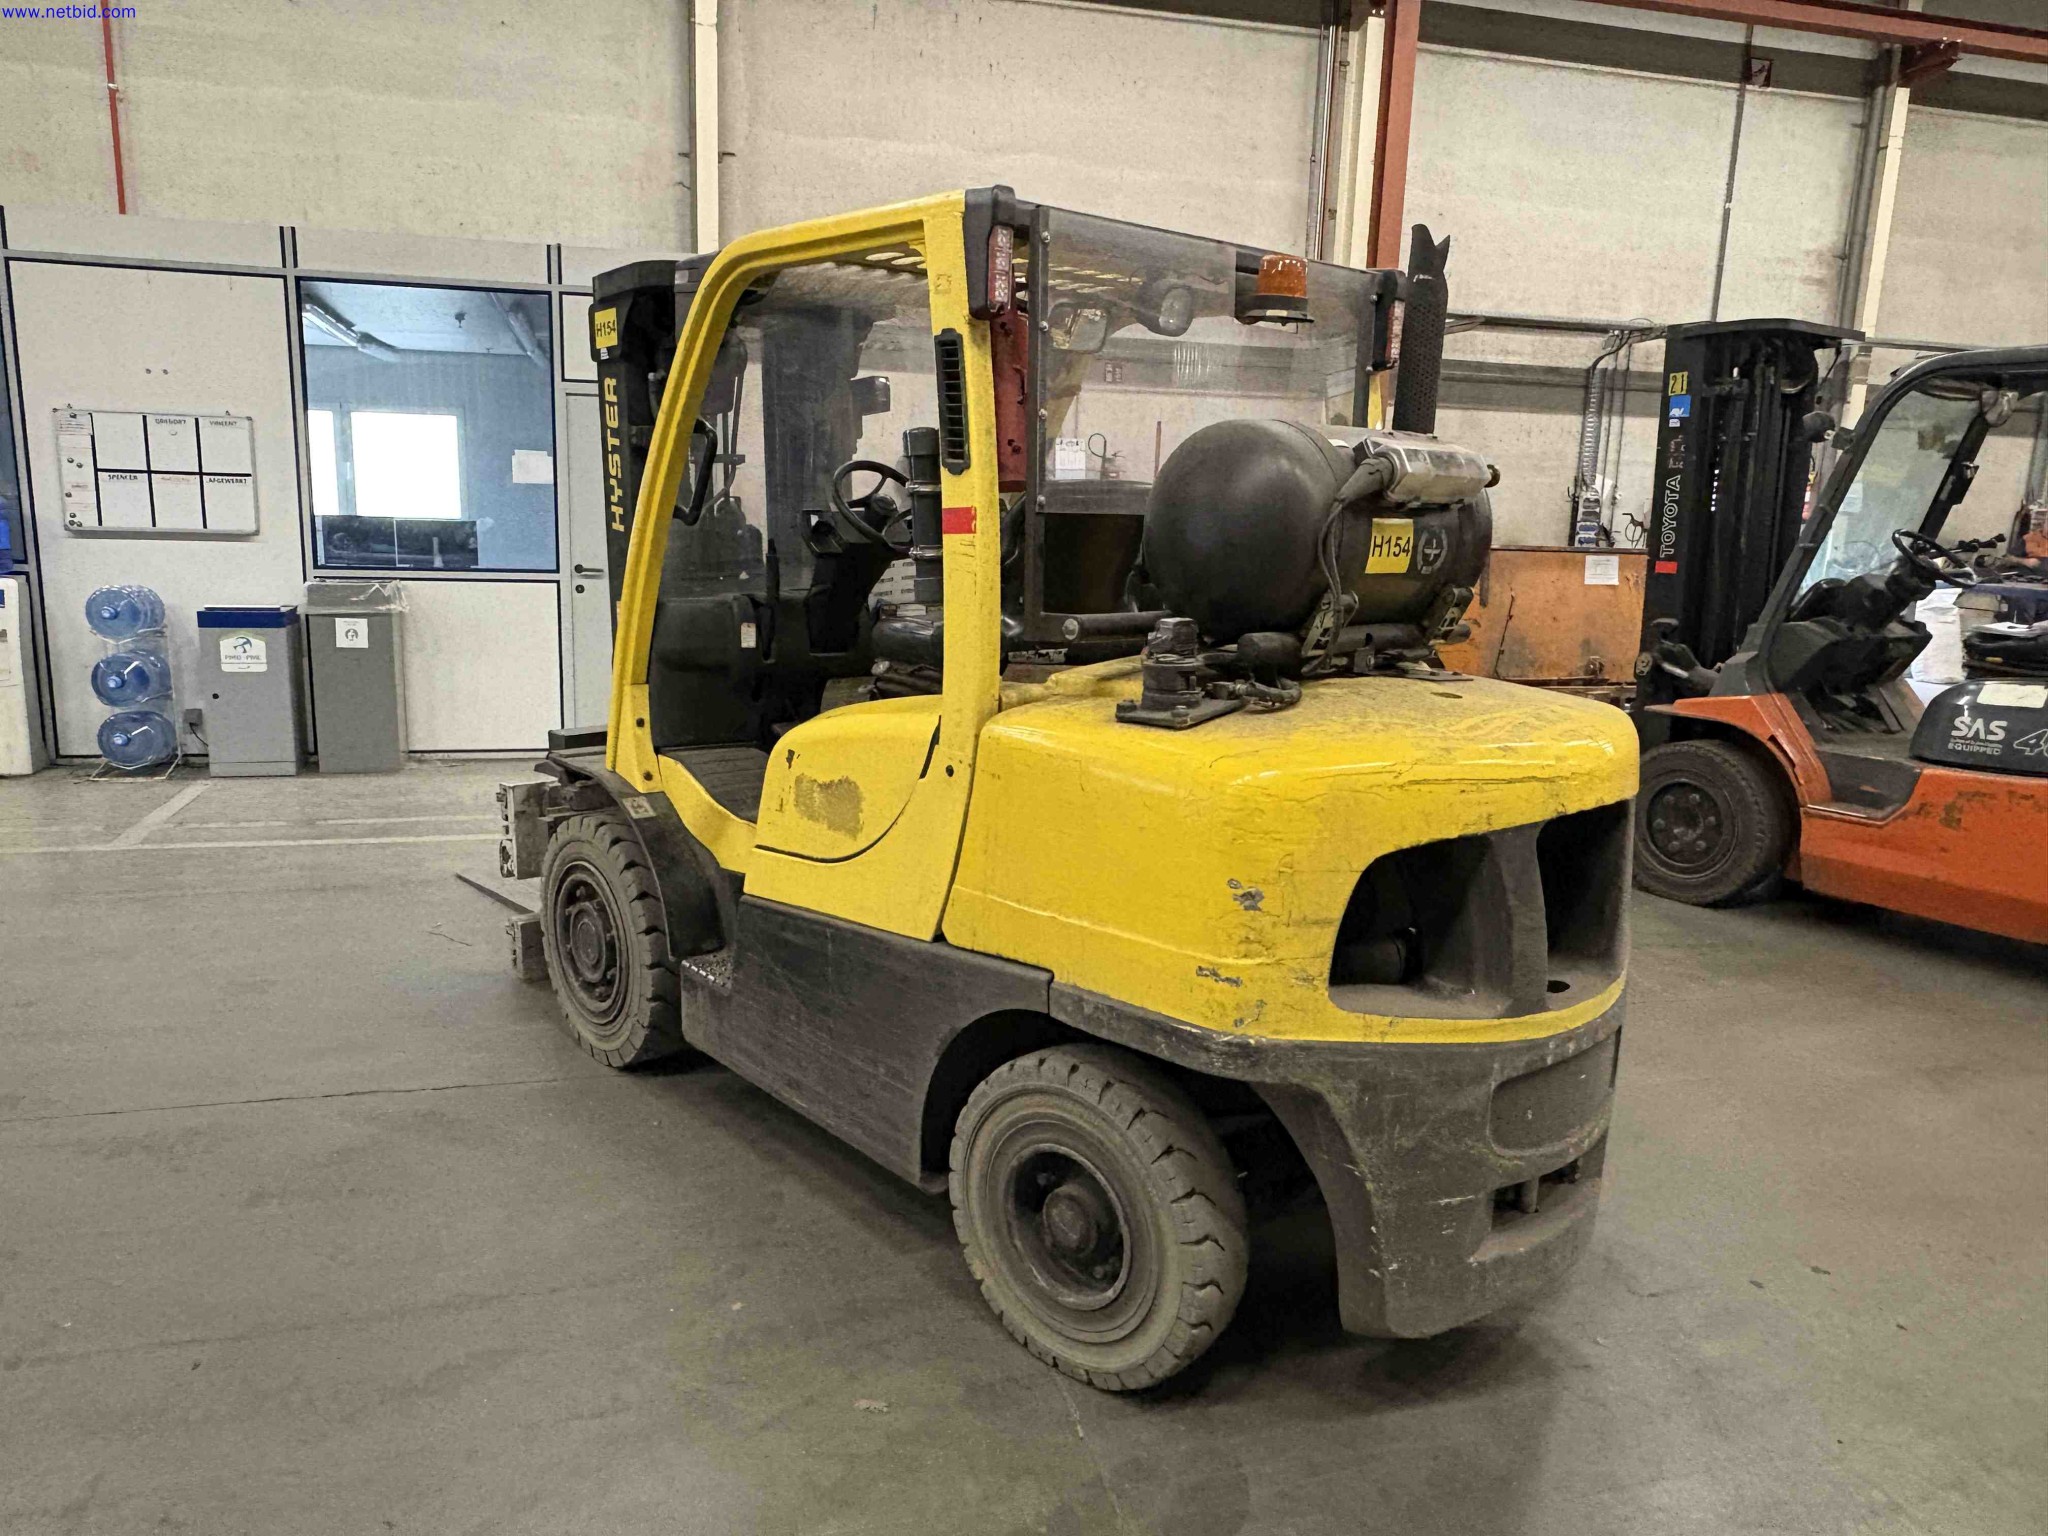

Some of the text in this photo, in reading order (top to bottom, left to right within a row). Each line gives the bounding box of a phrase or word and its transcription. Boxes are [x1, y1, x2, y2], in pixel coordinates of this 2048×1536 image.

[596, 319, 617, 337] H154
[1669, 374, 1685, 394] 21
[603, 377, 625, 532] HYSTER
[1659, 474, 1681, 558] TOYOTA
[1371, 535, 1411, 558] H154
[1951, 716, 2008, 741] SAS
[1948, 742, 2001, 755] EQUIPPED
